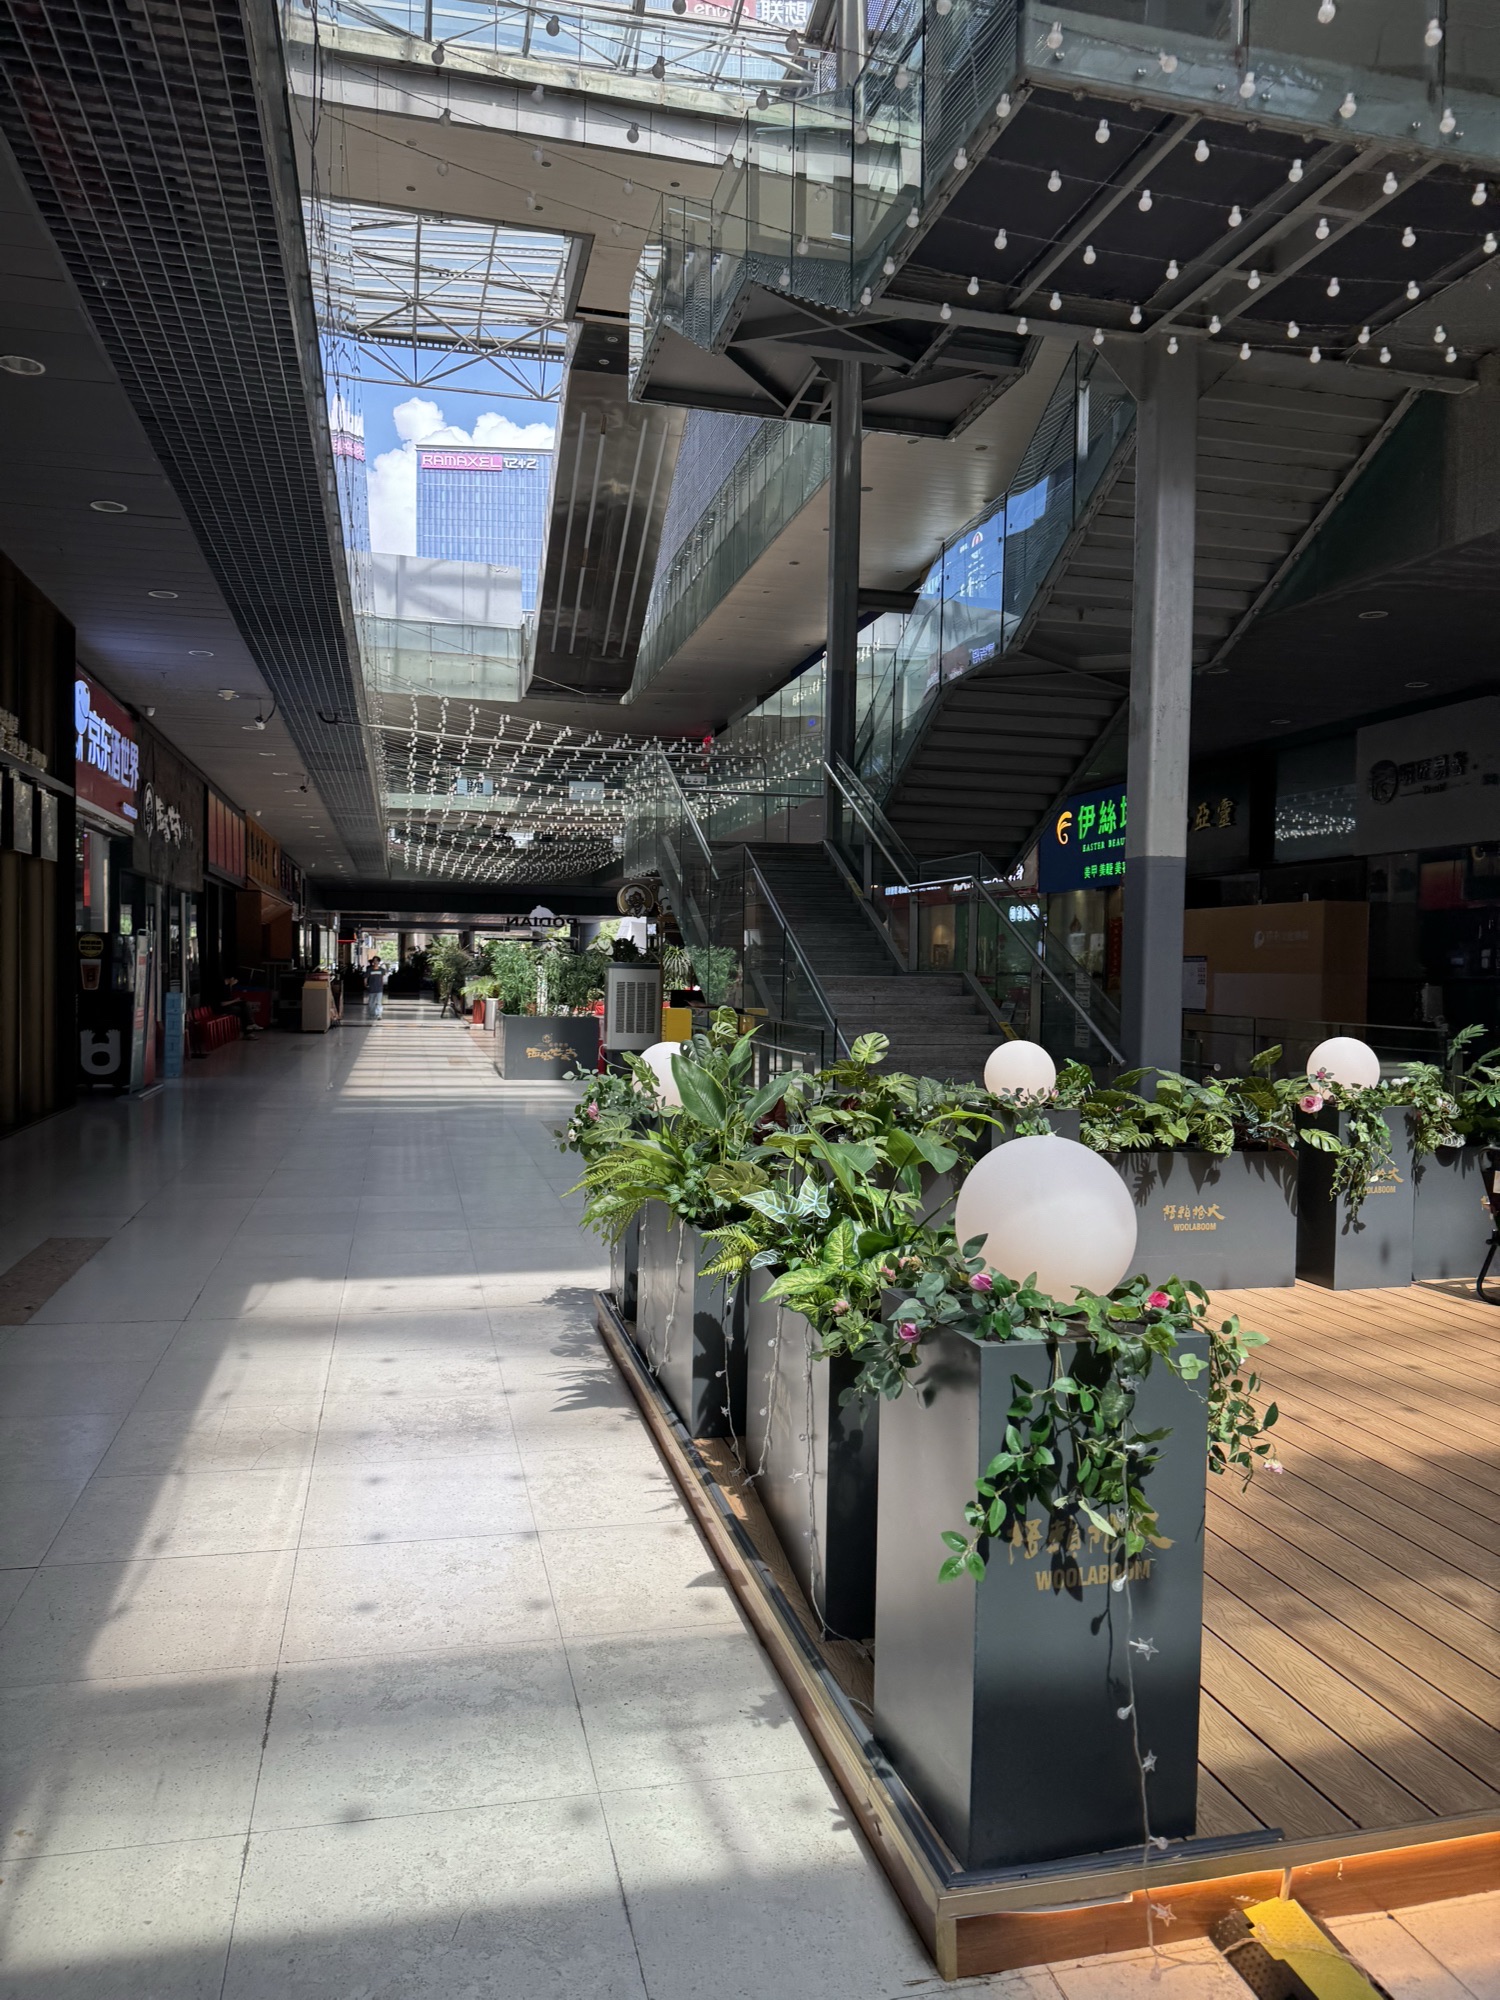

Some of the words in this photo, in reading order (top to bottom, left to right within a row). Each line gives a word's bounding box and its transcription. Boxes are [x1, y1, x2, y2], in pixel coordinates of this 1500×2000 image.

[759, 0, 808, 24] 联想
[422, 454, 502, 469] RAMAXEL
[87, 710, 140, 792] 京东酒世界
[1082, 840, 1106, 853] EASTER
[1107, 837, 1126, 849] BEAU
[1363, 1185, 1397, 1195] OLABOOM
[1173, 1222, 1217, 1232] WOOLABOOM
